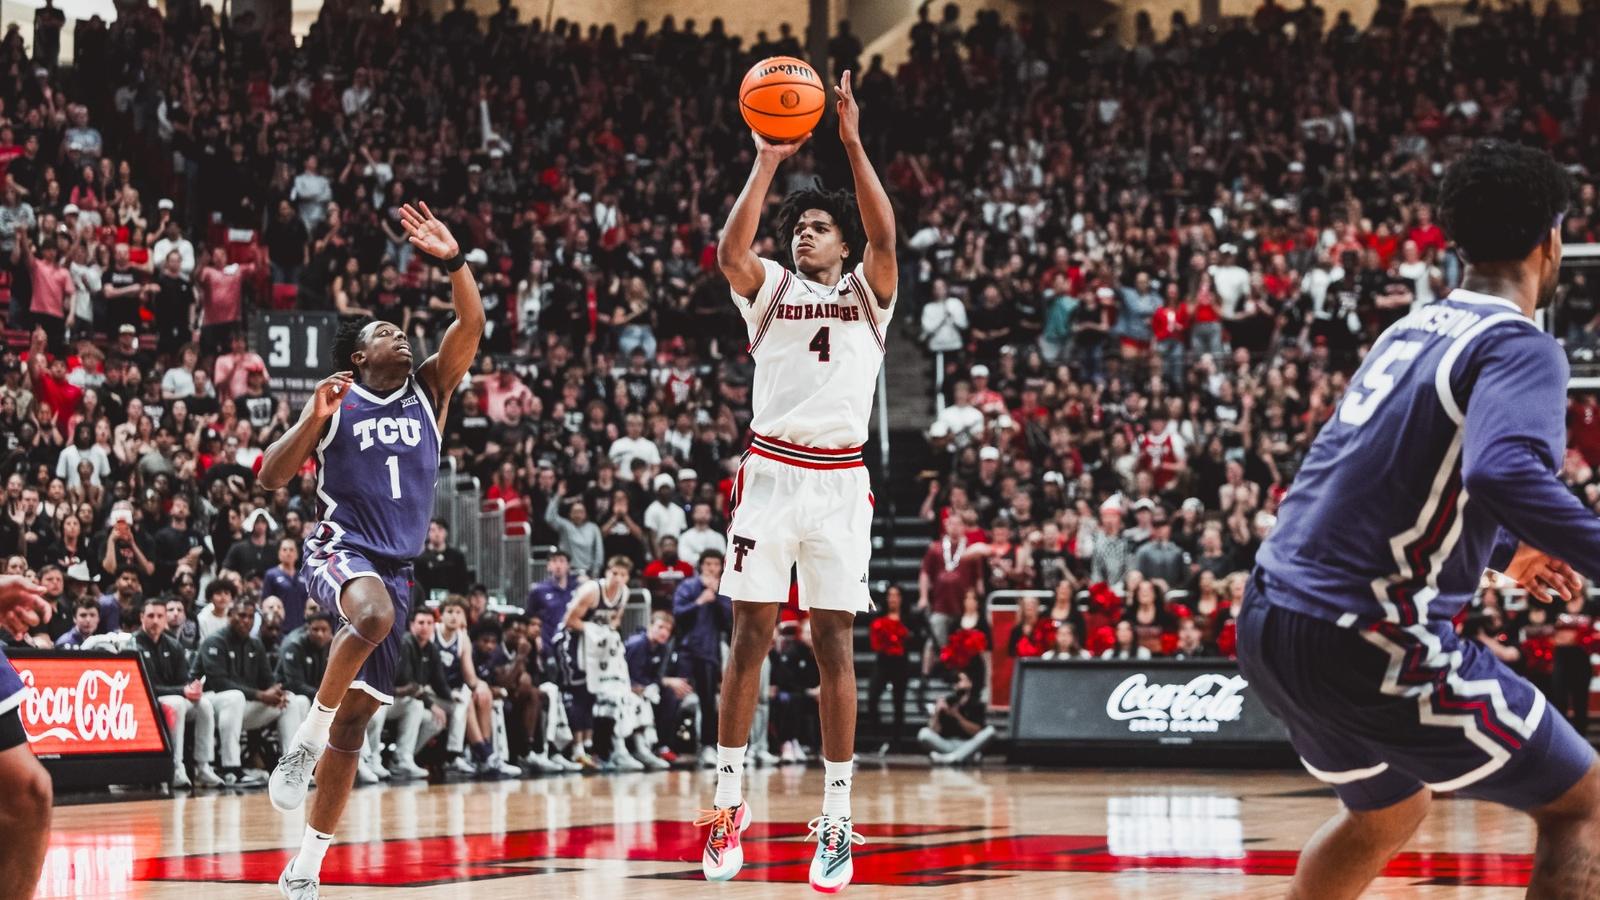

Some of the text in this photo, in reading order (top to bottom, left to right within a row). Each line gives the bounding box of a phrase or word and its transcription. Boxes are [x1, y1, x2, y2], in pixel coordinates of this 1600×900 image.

[759, 63, 814, 80] Wilson
[776, 303, 803, 320] RED
[808, 326, 830, 362] 4
[1339, 340, 1423, 427] 5
[353, 417, 422, 451] TCU
[385, 455, 402, 499] 1
